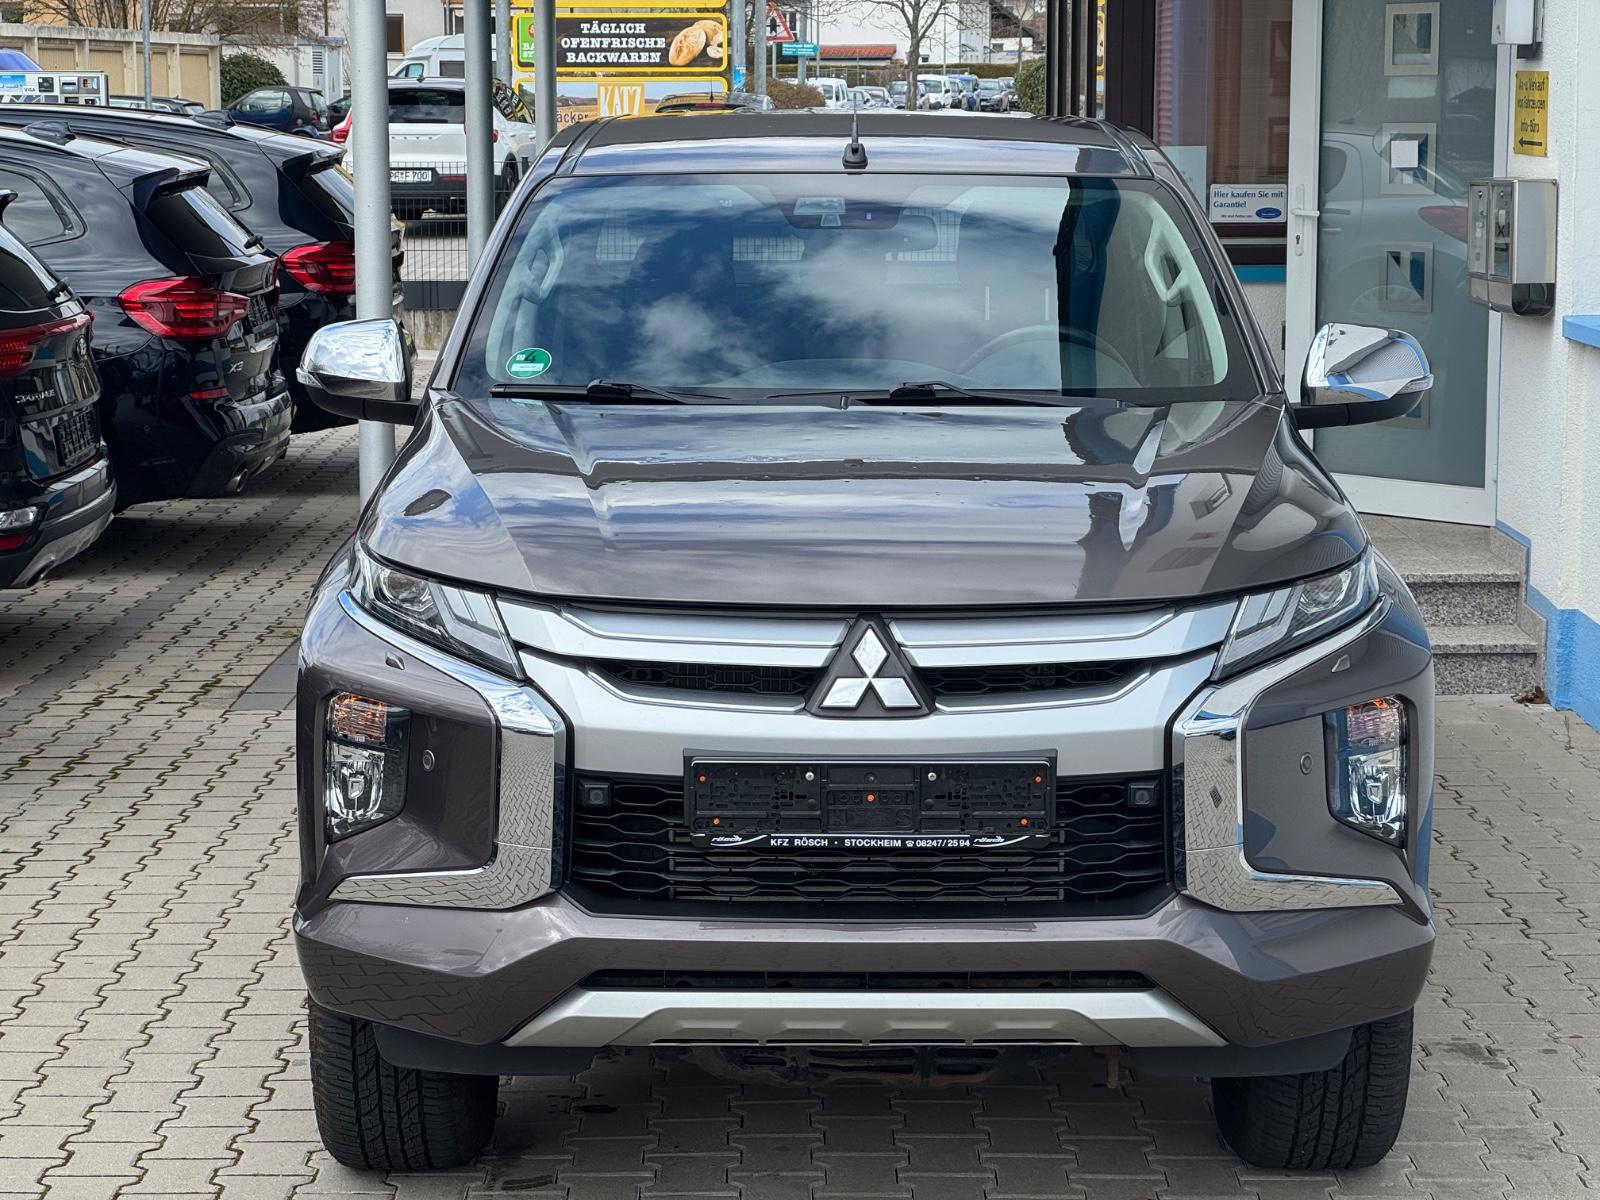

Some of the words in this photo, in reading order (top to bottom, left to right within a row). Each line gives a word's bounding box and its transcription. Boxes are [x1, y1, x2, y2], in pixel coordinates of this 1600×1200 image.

[581, 21, 646, 34] TÄGLICH
[561, 38, 666, 49] OFENFRISCHE
[566, 52, 661, 63] BACKWAREN
[599, 86, 642, 116] KATZ
[556, 110, 589, 124] äcker
[1231, 190, 1256, 198] kaufen
[1258, 190, 1269, 198] Sie
[1271, 190, 1284, 198] mit
[770, 838, 789, 846] KFZ
[794, 836, 828, 846] RÖSCH
[844, 838, 902, 847] STOCKHEIM
